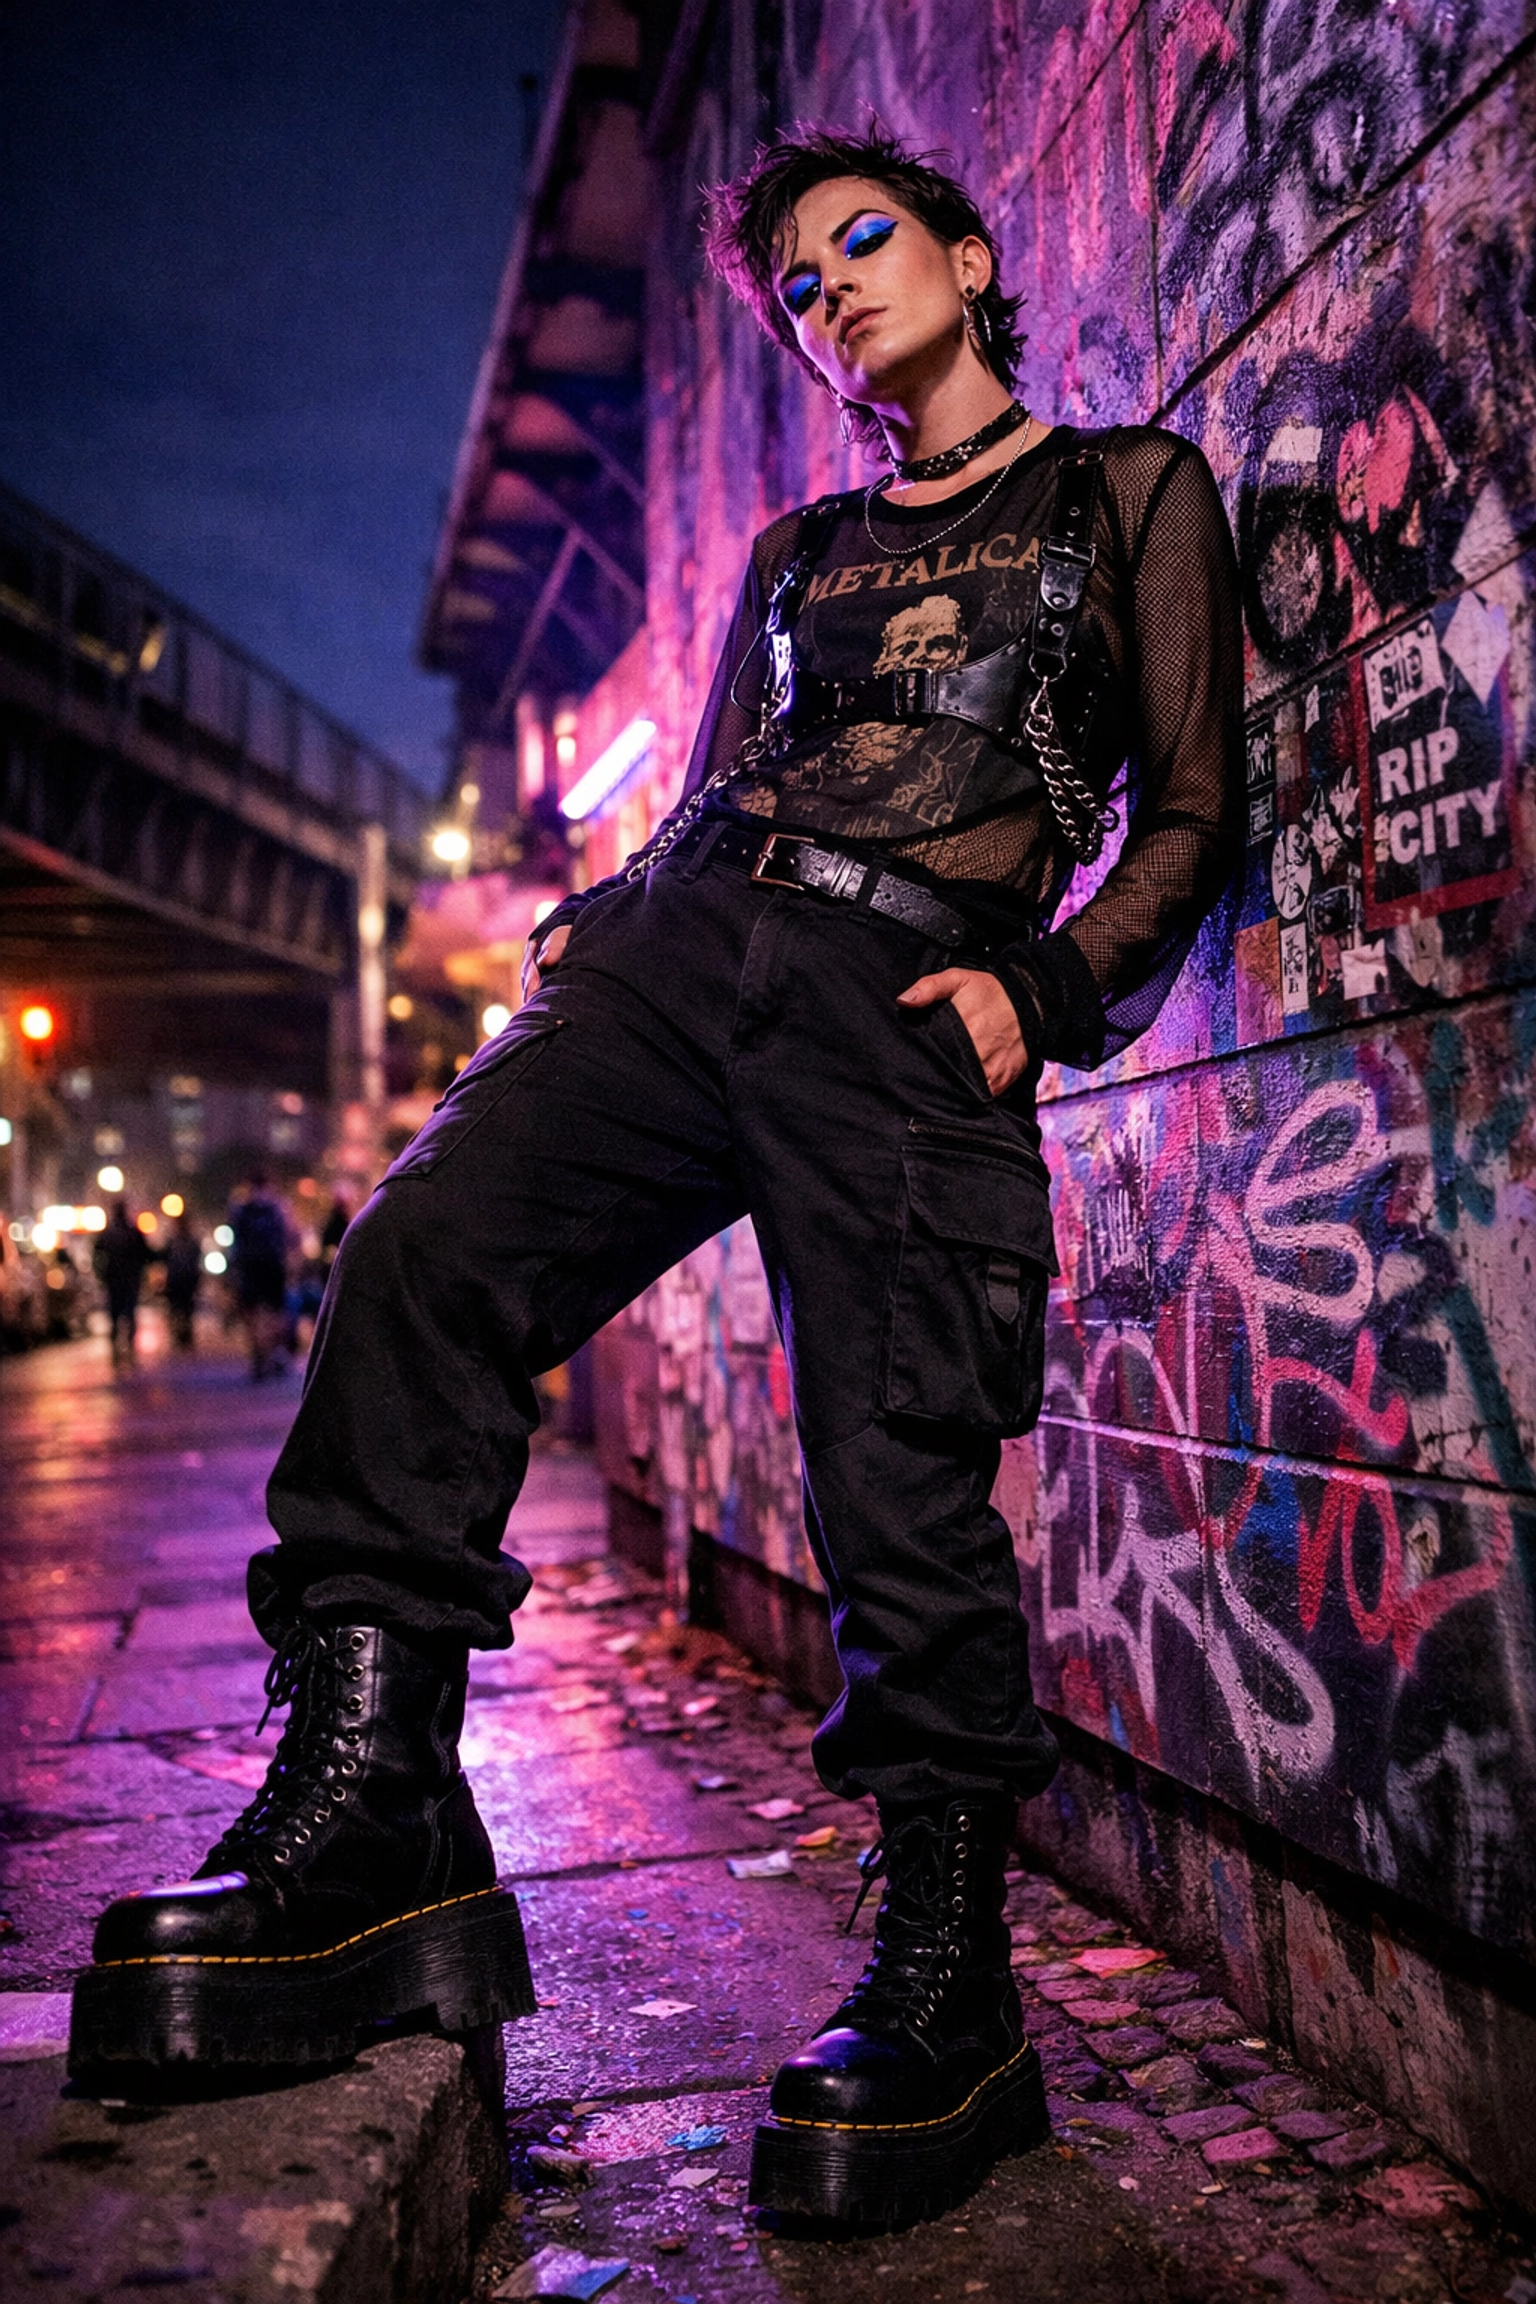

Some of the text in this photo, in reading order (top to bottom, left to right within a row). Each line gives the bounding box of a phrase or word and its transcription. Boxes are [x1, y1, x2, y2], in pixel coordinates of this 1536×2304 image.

[797, 533, 1041, 615] METALICA
[1377, 726, 1459, 804] RIP
[1390, 780, 1502, 865] CITY
